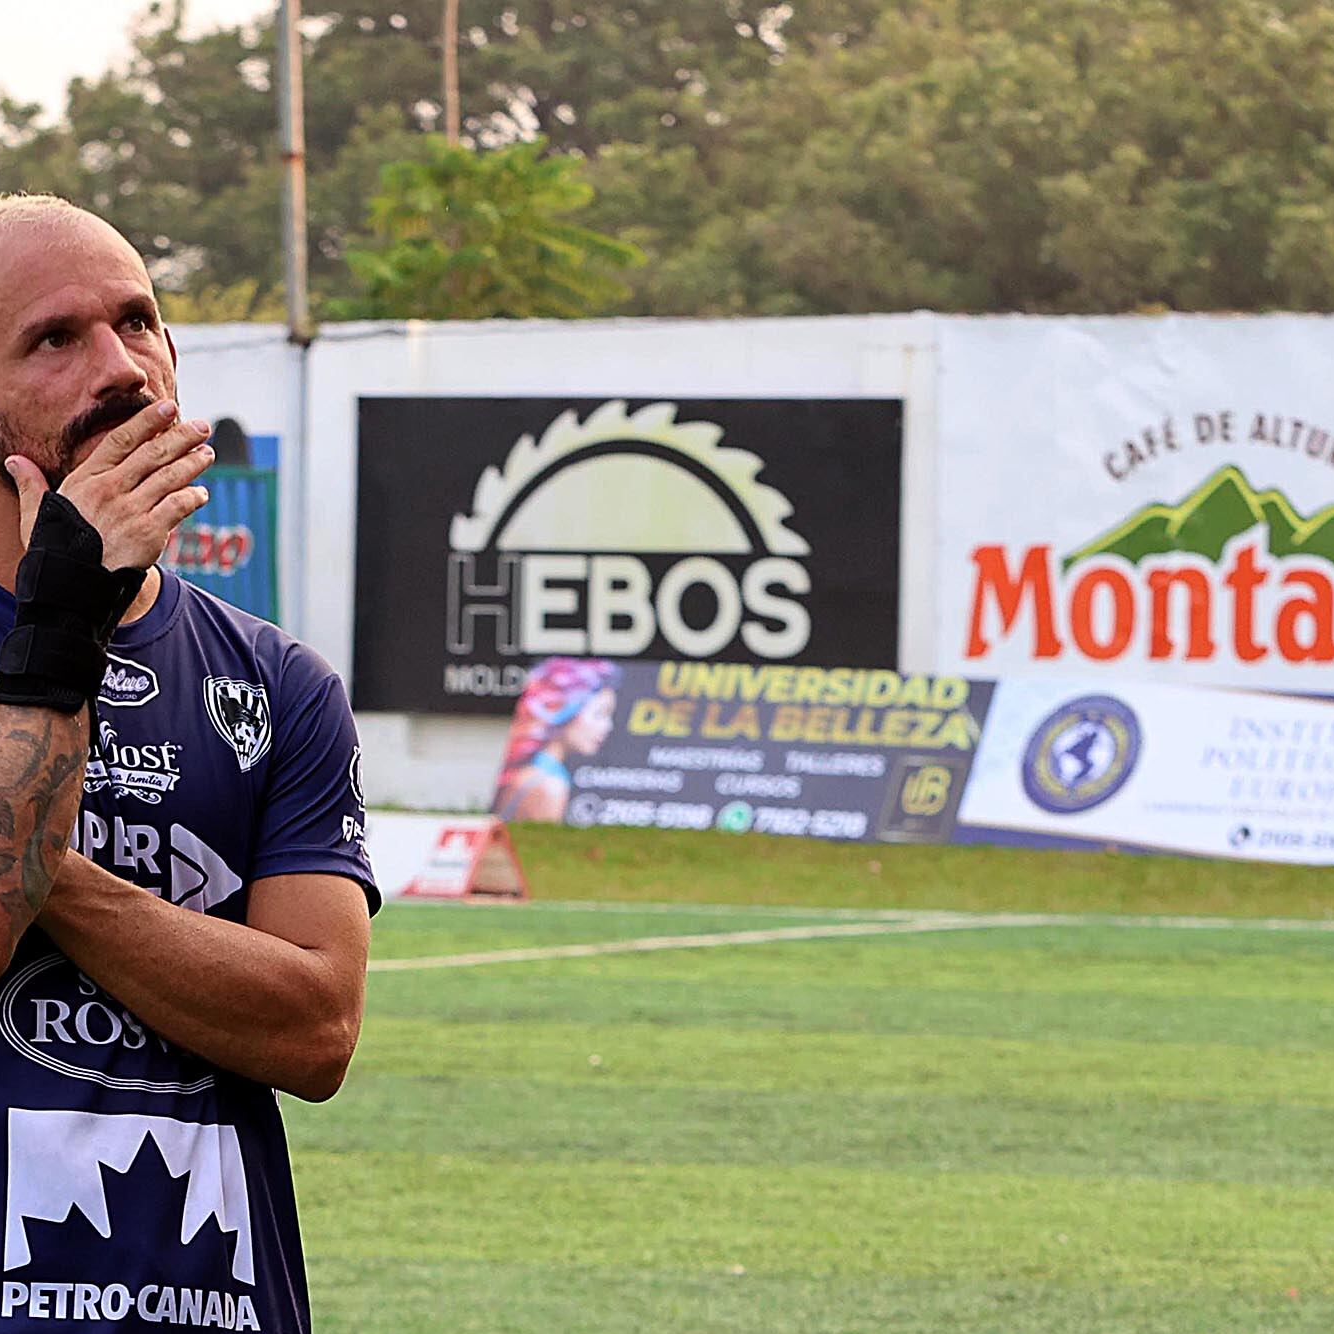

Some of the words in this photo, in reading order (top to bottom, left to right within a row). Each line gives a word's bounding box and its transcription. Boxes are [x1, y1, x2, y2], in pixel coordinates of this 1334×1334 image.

[1194, 411, 1236, 444] DE
[446, 552, 811, 658] HEBOS
[656, 660, 969, 709] UNIVERSIDAD
[627, 699, 692, 737] DE
[699, 702, 761, 740] LA
[769, 705, 971, 750] BELLEZA
[106, 741, 181, 773] JOSÉ
[30, 999, 167, 1053] ROS
